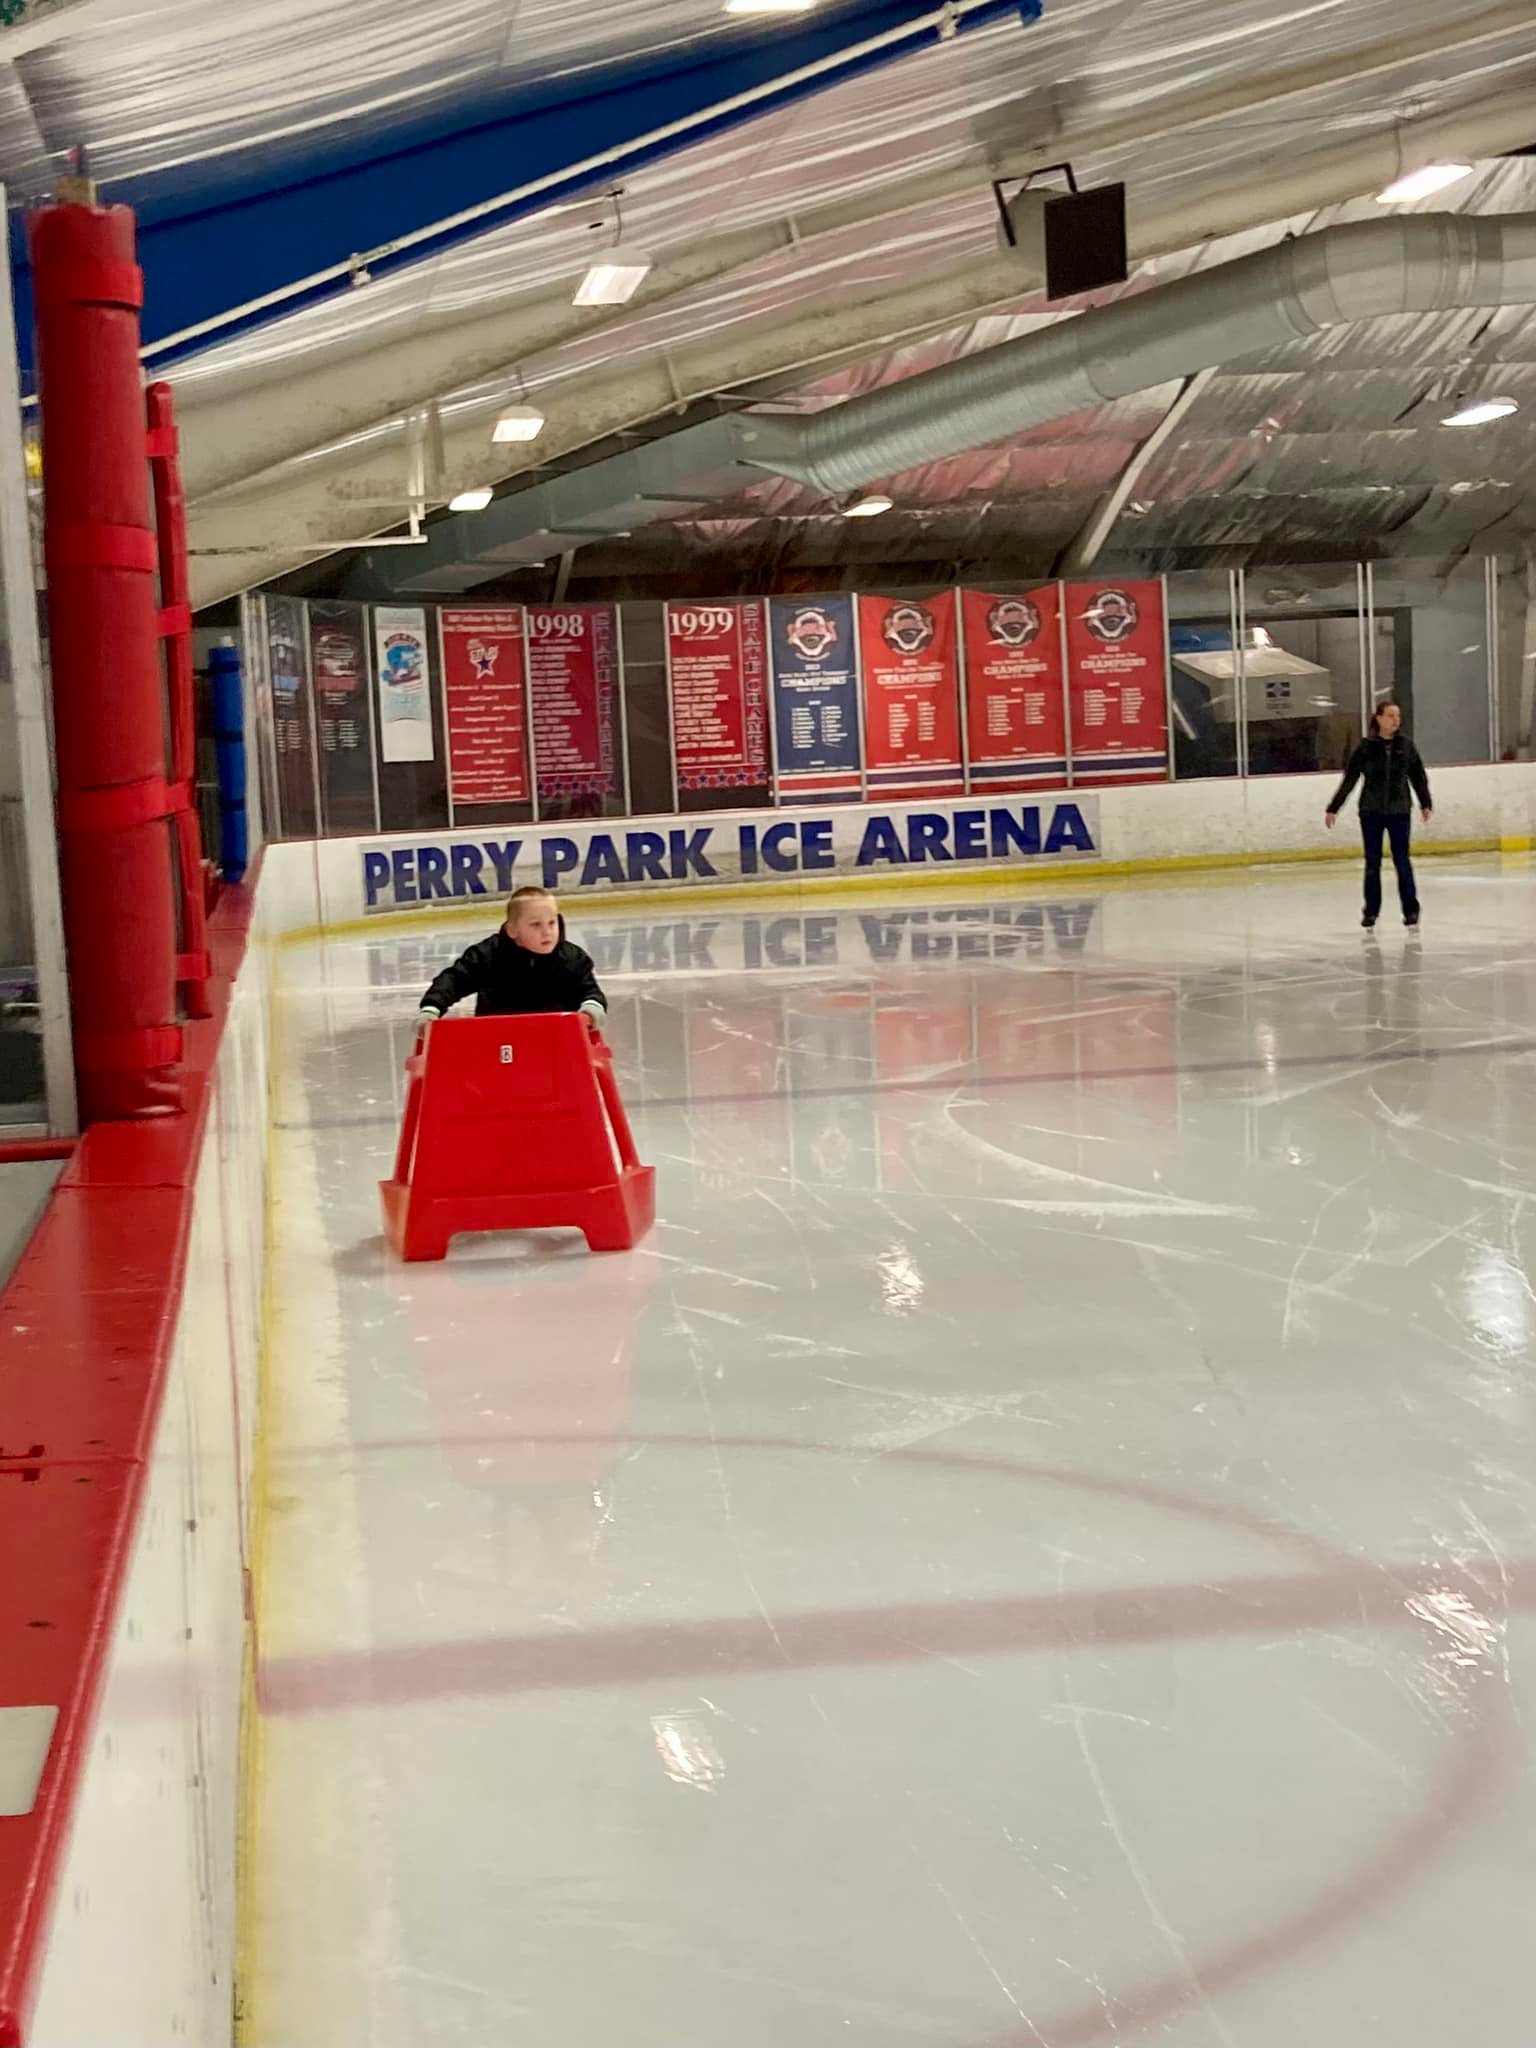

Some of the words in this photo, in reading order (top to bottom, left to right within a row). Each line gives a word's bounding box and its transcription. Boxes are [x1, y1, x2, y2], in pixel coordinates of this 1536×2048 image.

[528, 614, 585, 638] 1998
[669, 611, 734, 636] 1999
[364, 840, 523, 906] PERRY
[541, 828, 716, 889] PARK
[739, 820, 836, 874] ICE
[855, 802, 1095, 867] ARENA
